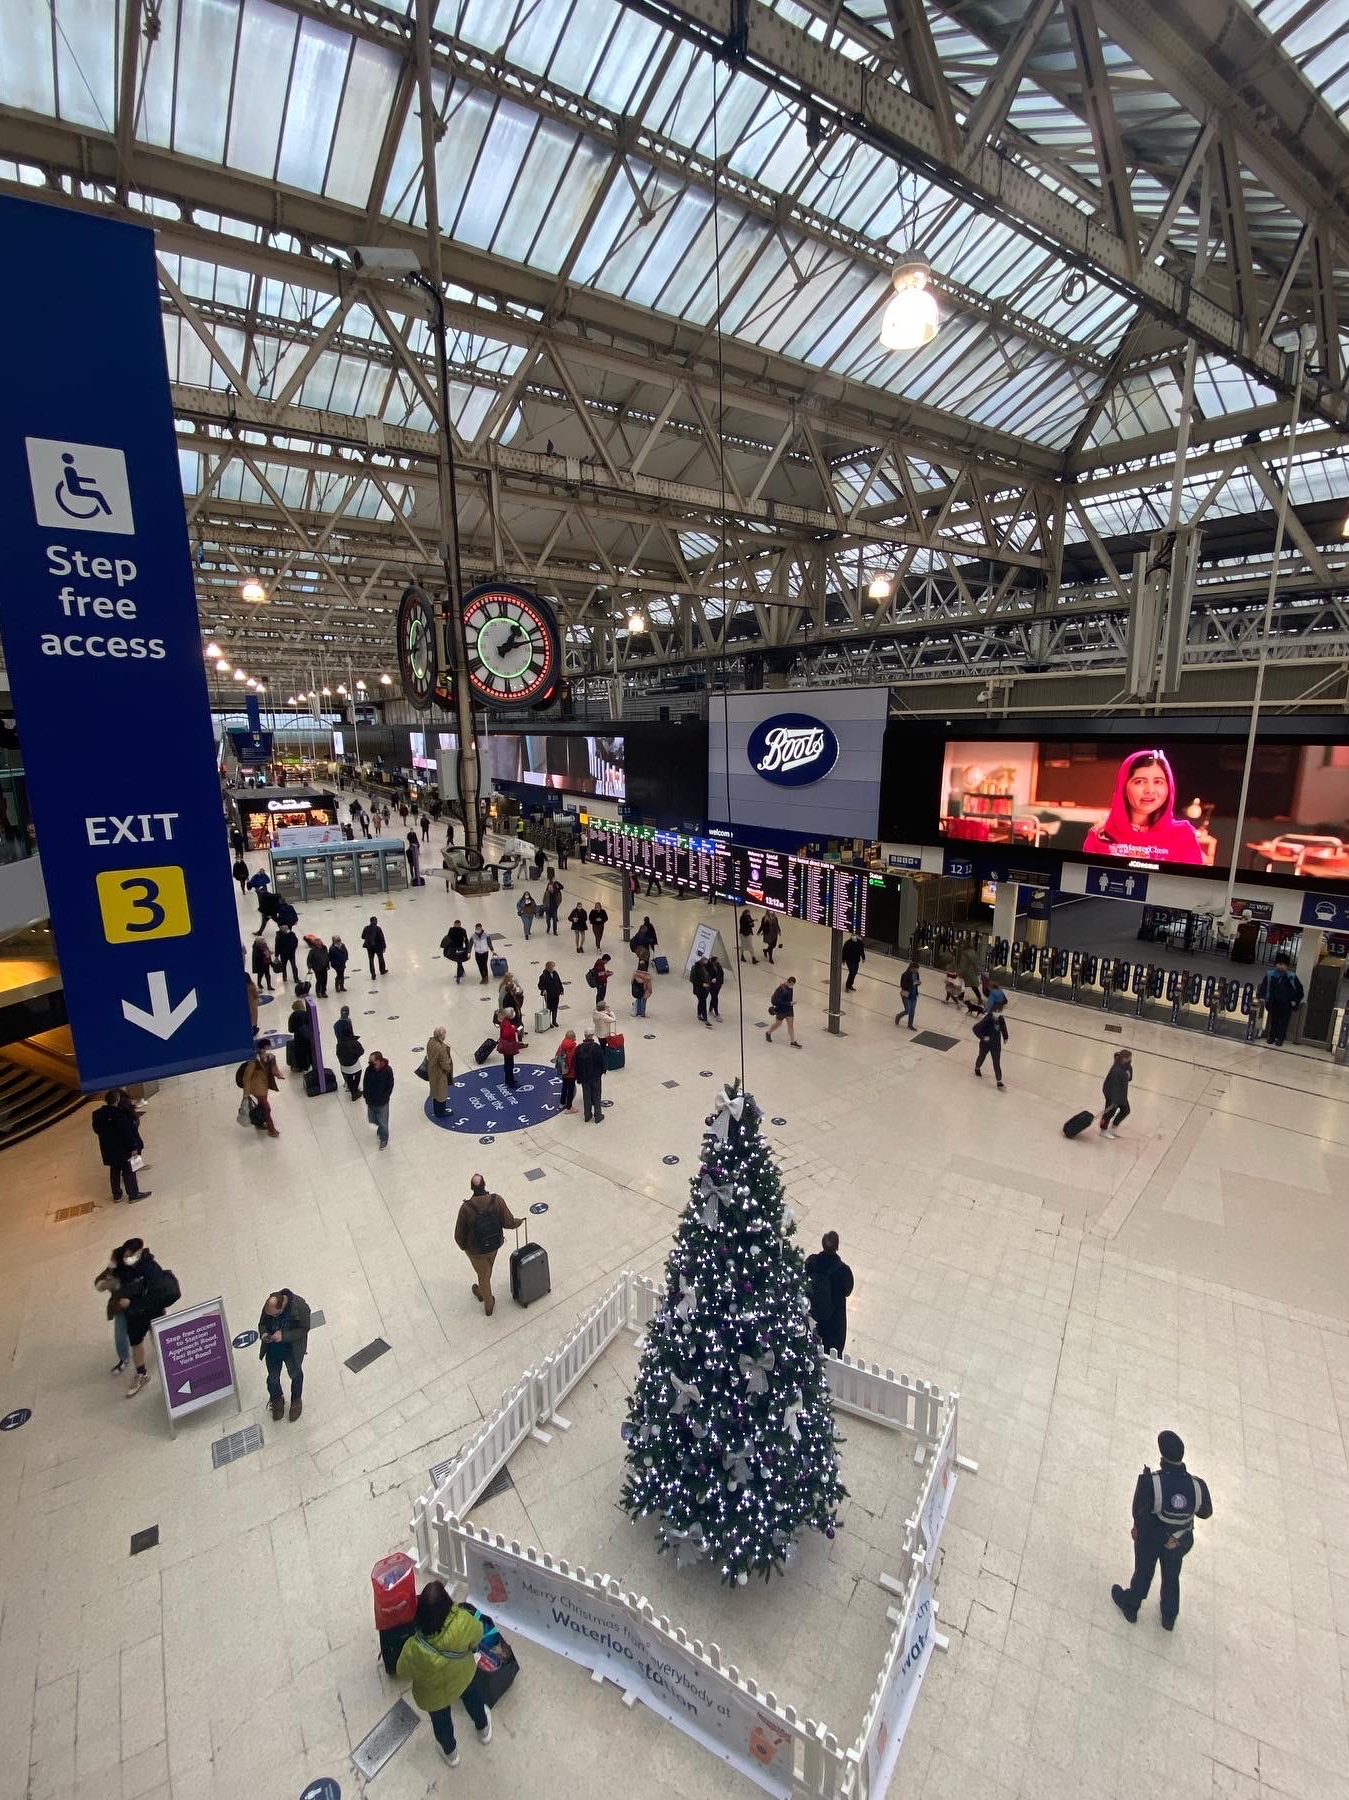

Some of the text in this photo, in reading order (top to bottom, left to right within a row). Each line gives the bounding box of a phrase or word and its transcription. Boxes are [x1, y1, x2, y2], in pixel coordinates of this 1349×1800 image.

[46, 545, 137, 587] Step
[58, 587, 137, 619] free
[41, 633, 166, 659] access
[757, 727, 824, 772] Boots
[85, 813, 179, 845] EXIT
[950, 864, 973, 874] 12 12
[120, 878, 165, 932] 3
[1154, 912, 1168, 921] 12
[1329, 943, 1345, 953] 13
[454, 1081, 465, 1089] 8
[548, 1076, 564, 1086] 12
[469, 1096, 486, 1110] clock
[540, 1103, 555, 1111] 2
[455, 1117, 469, 1126] 5
[486, 1120, 497, 1129] 4
[517, 1114, 530, 1123] 3
[165, 1322, 216, 1344] Step free access
[185, 1331, 208, 1343] Station
[168, 1341, 199, 1357] Approach
[172, 1353, 185, 1361] Taxi
[187, 1347, 203, 1356] Rank
[179, 1349, 211, 1365] York Road
[551, 1608, 634, 1660] Waterloo
[522, 1580, 557, 1604] Merry
[560, 1596, 620, 1632] Christmas
[717, 1703, 731, 1718] at
